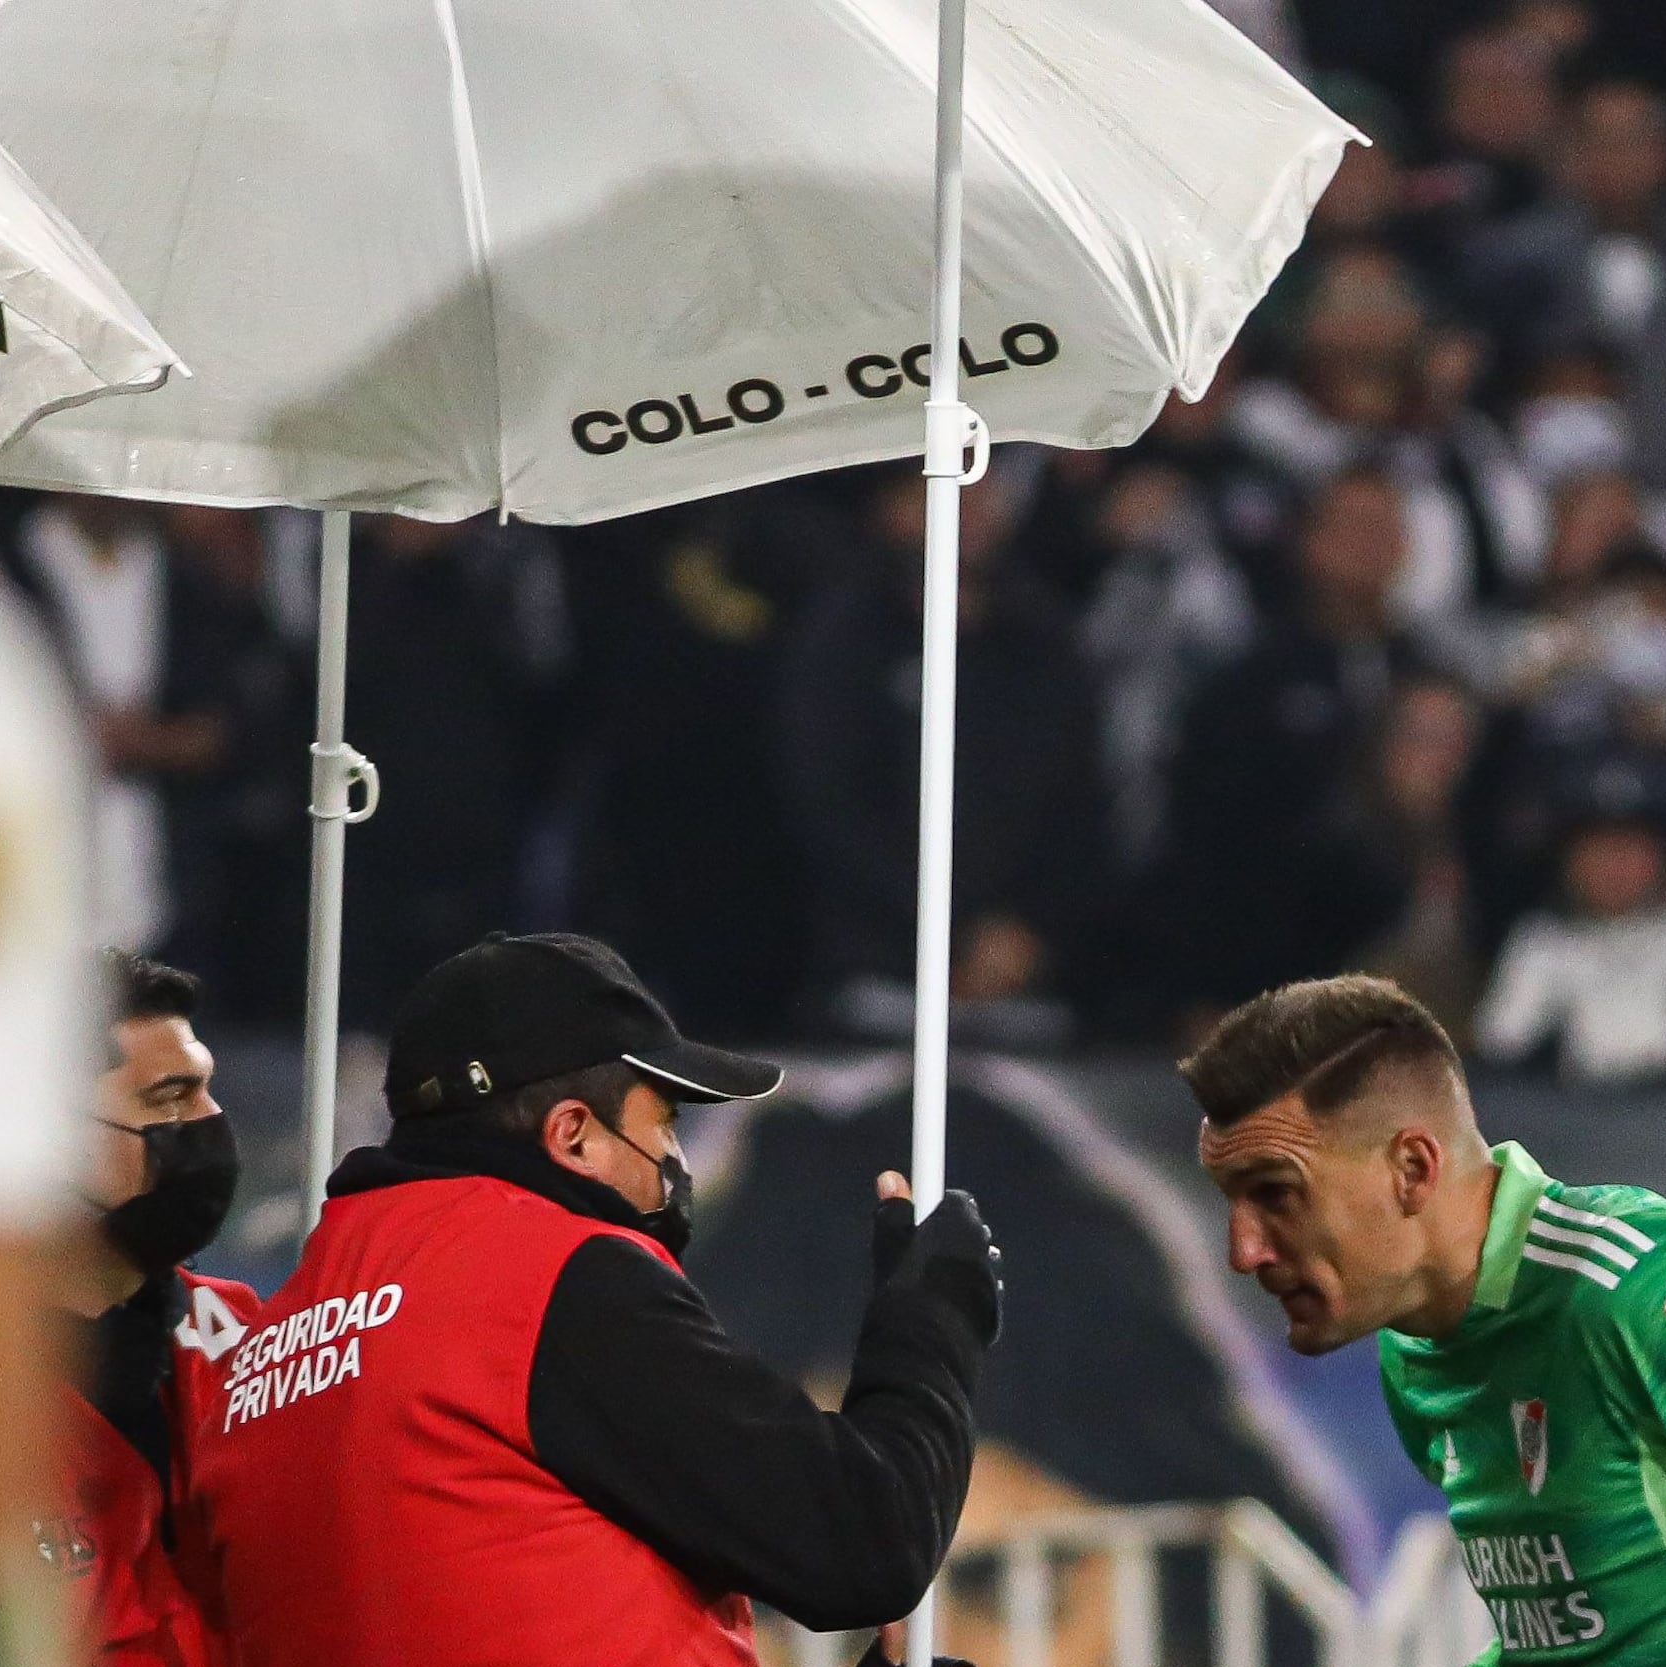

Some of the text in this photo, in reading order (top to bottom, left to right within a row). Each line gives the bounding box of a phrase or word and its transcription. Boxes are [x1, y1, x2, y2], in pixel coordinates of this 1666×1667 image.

[571, 377, 785, 455] COLO
[224, 1283, 403, 1390] SEGURIDAD
[223, 1337, 361, 1434] PRIVADA
[1460, 1533, 1575, 1588] URKISH
[1489, 1590, 1606, 1650] LINES
